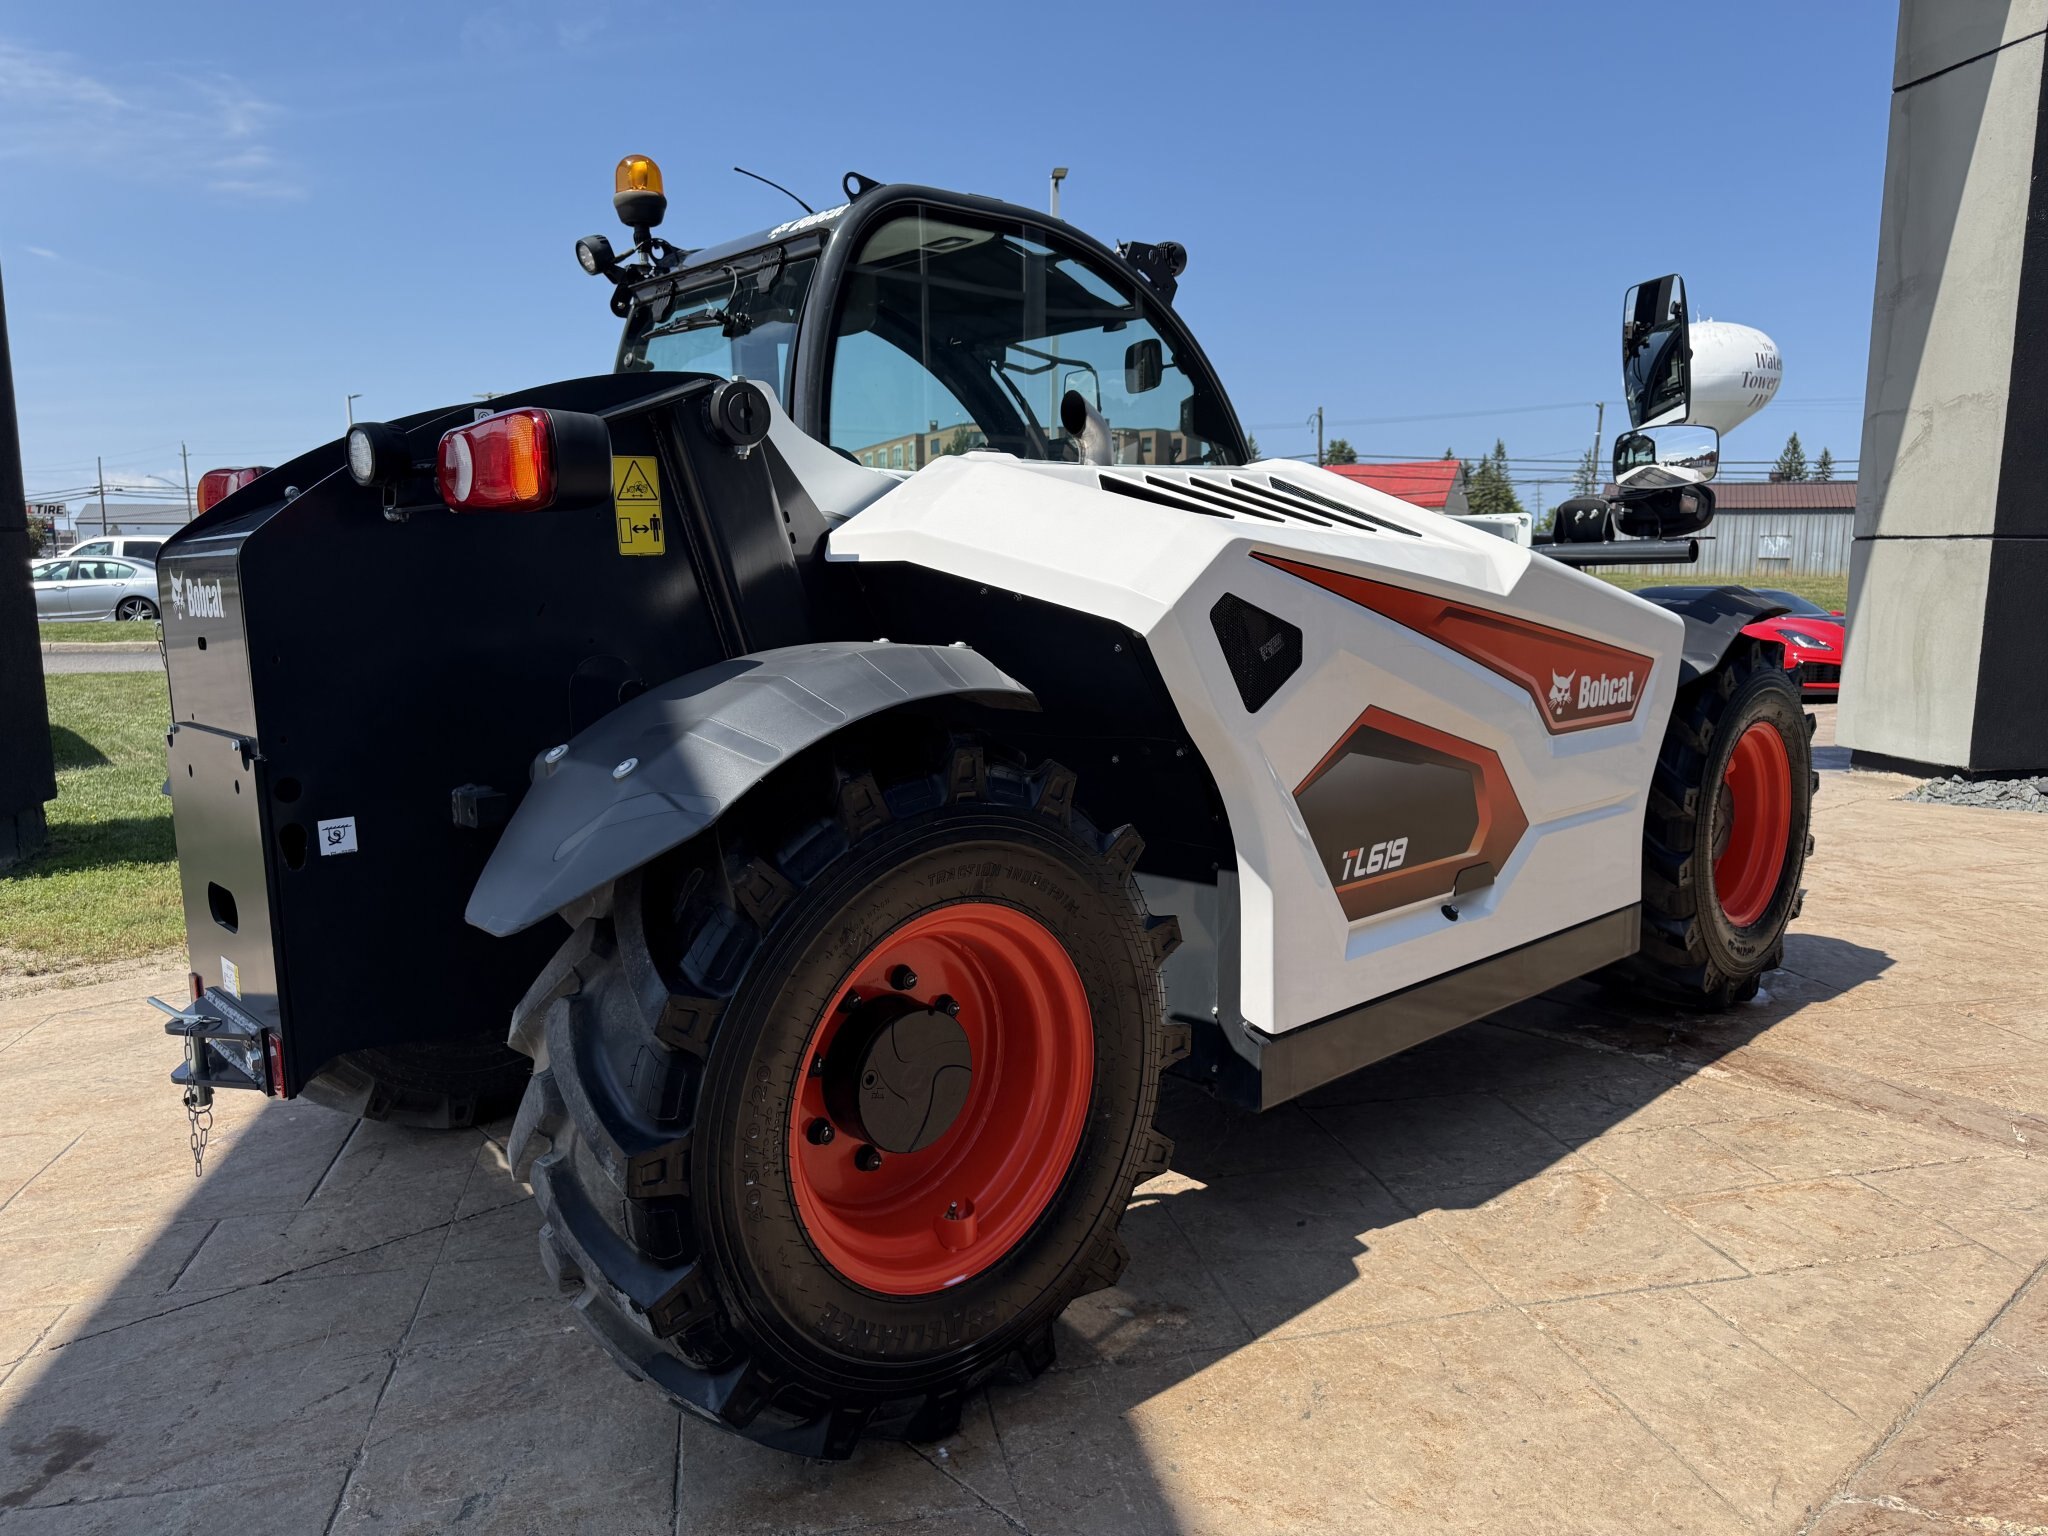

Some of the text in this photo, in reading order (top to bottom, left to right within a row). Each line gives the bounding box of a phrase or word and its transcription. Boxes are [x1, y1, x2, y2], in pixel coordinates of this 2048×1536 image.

[1755, 352, 1782, 371] Wate
[1742, 371, 1777, 391] Tower
[36, 505, 64, 514] TIRE
[186, 578, 224, 618] Bobcat
[1578, 671, 1634, 710] Bobcat
[1342, 836, 1409, 881] TL619
